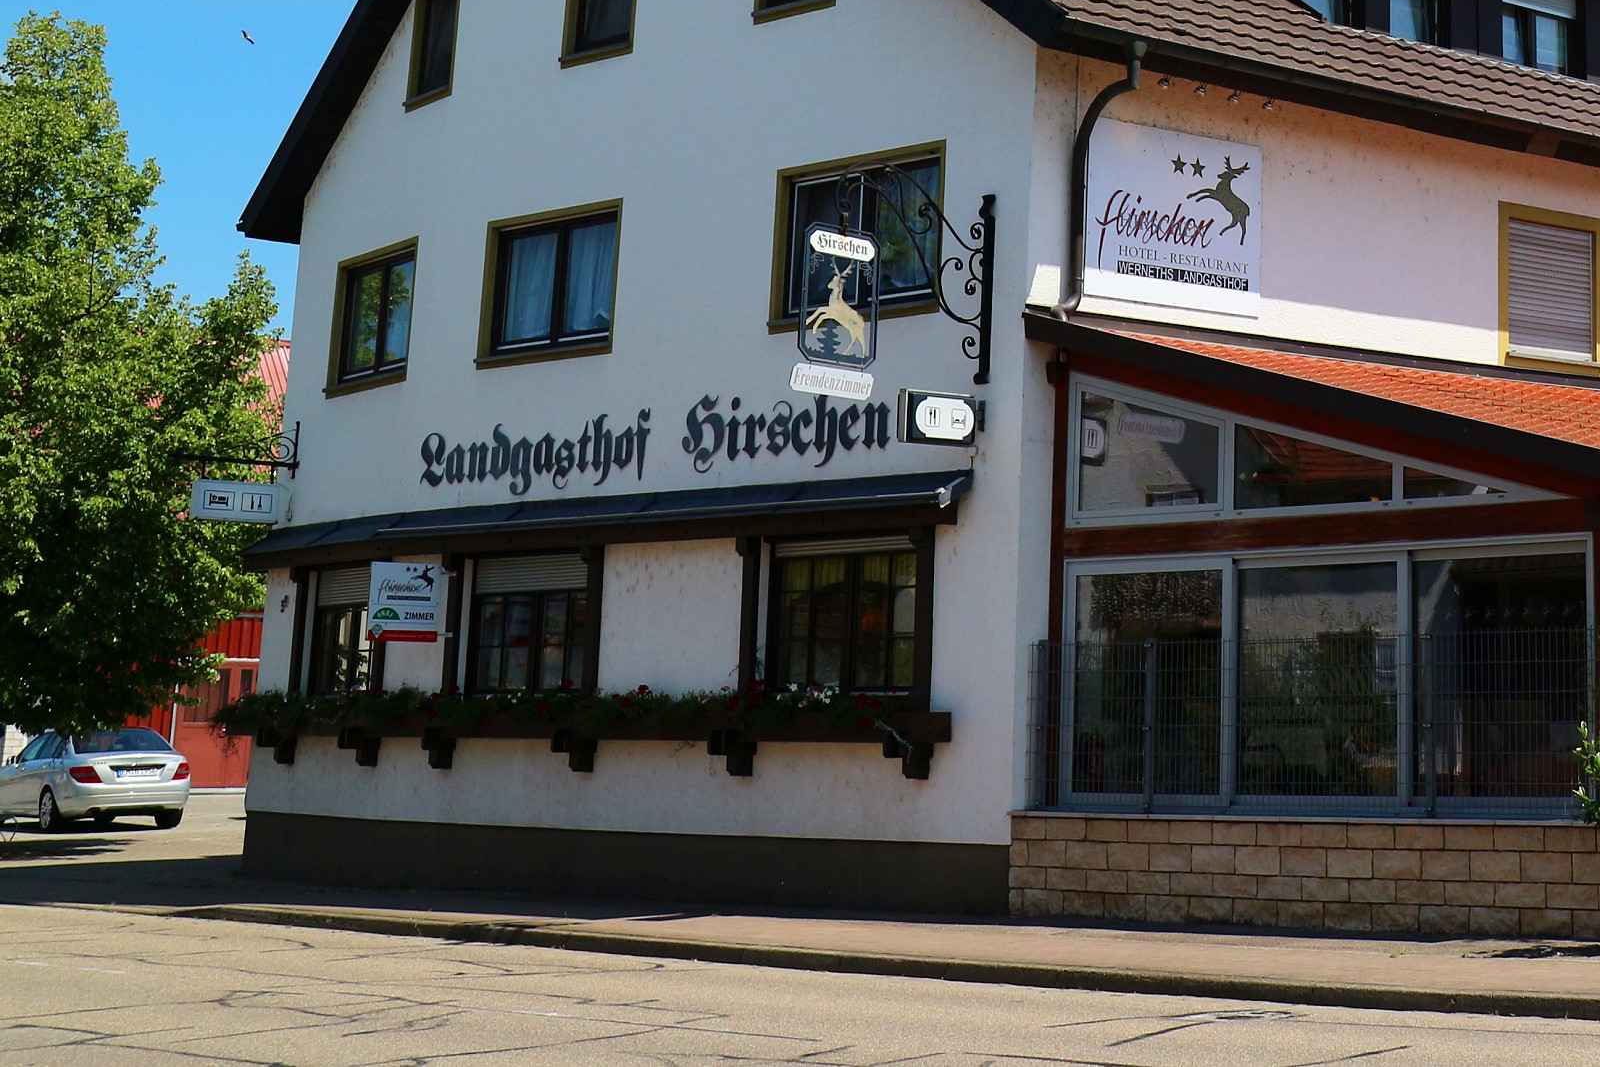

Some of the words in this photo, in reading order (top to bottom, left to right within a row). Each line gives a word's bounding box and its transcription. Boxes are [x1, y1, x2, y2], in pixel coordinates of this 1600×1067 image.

[817, 233, 868, 257] Hirschen
[1118, 245, 1160, 261] HOTEL
[1170, 252, 1249, 274] RESTAURANT
[1118, 261, 1174, 280] WERNETHS
[1178, 270, 1247, 290] LANDGASTHOF
[793, 368, 871, 395] Fremdenzimmer
[420, 408, 650, 495] Landgasthof
[682, 395, 890, 473] Hirschen
[377, 610, 393, 618] FREI
[404, 612, 434, 620] ZIMMER
